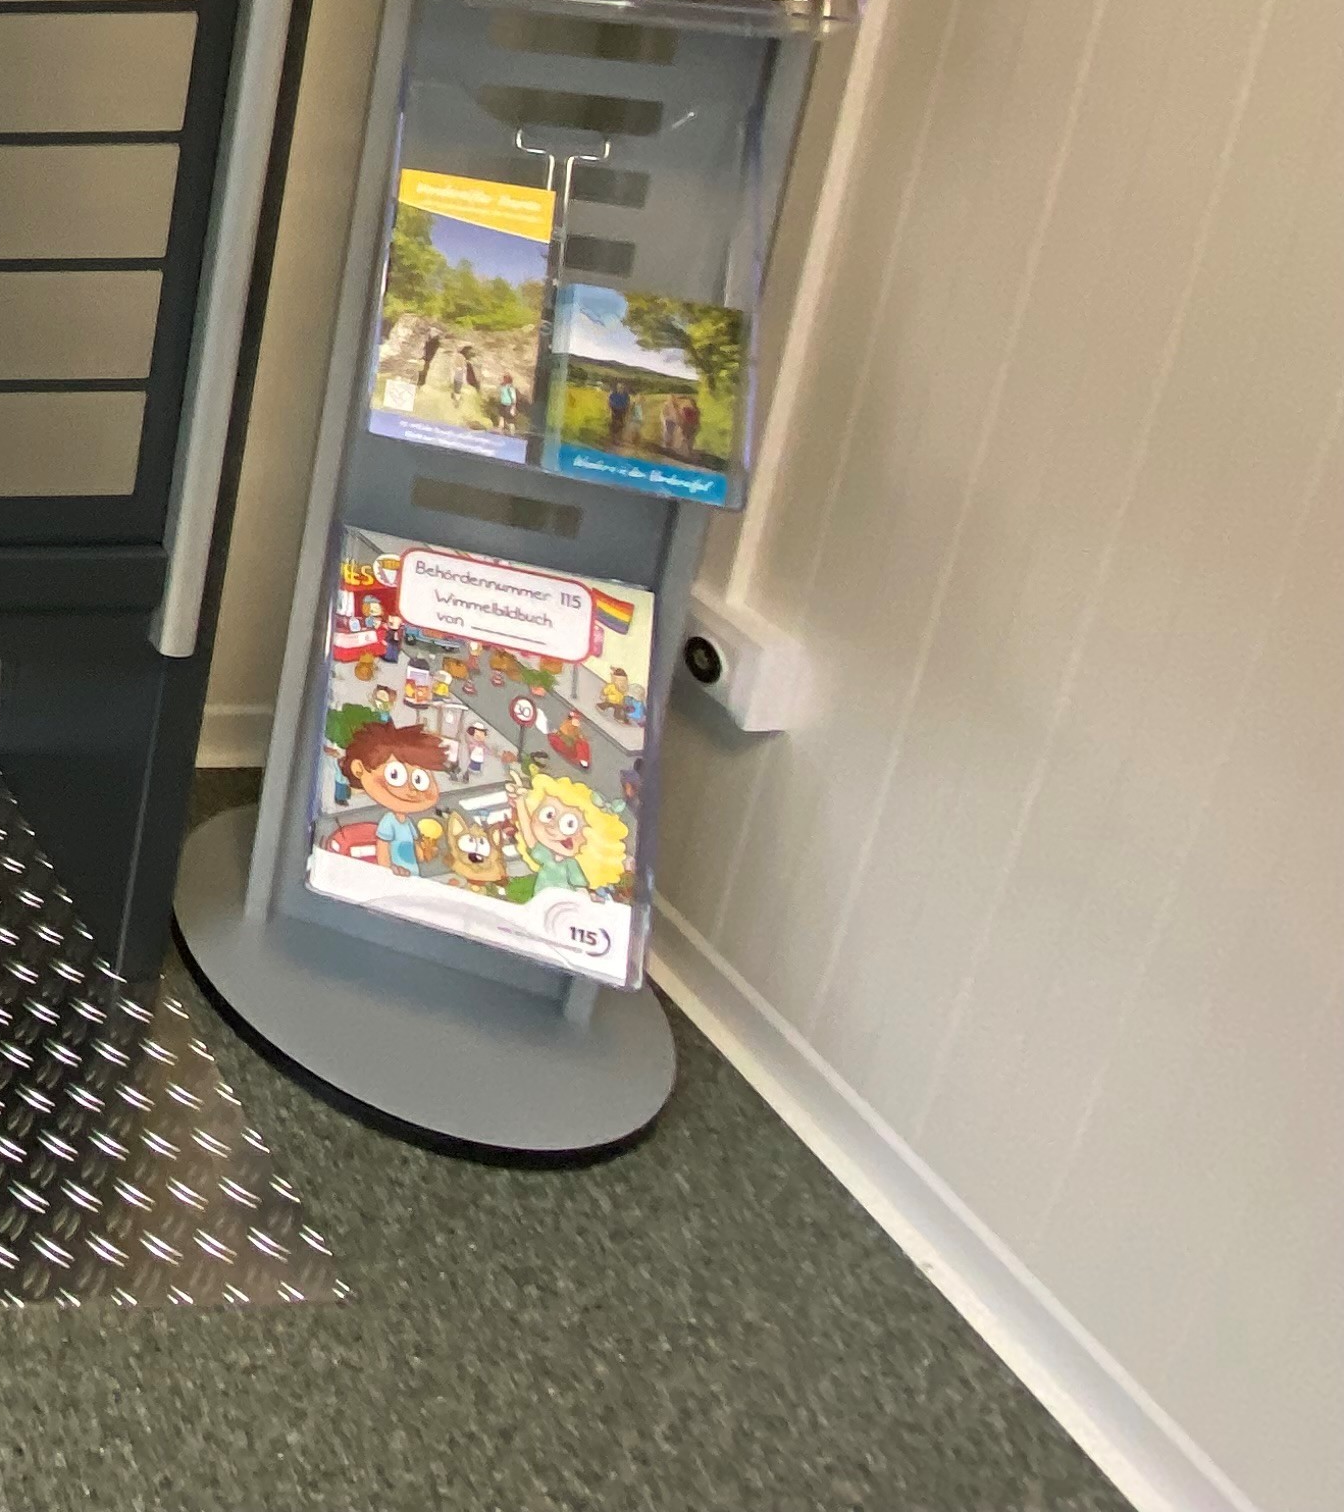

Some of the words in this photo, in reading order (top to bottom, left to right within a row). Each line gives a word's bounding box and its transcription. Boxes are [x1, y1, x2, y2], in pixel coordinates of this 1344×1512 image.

[415, 560, 551, 602] Behördennummer
[559, 591, 582, 610] 115
[434, 589, 554, 628] Wimmelbildbuch
[436, 610, 465, 627] von
[569, 926, 598, 947] 115
